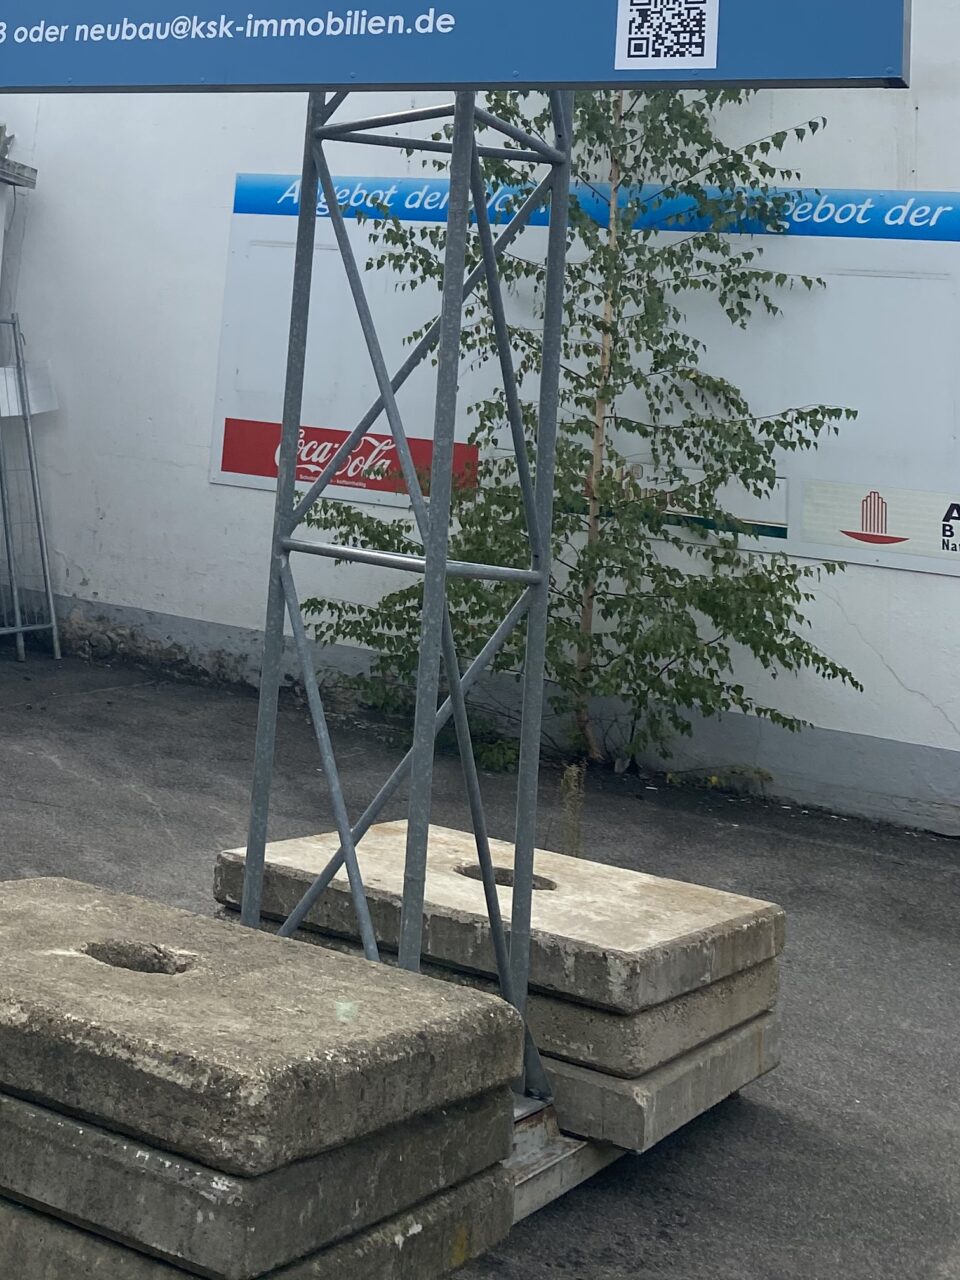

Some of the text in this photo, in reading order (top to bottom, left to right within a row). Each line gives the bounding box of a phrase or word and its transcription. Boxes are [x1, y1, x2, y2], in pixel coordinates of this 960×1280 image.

[13, 20, 69, 44] oder
[74, 7, 456, 42] neubau@ksk-immobilien.de
[277, 176, 398, 216] Agebot
[884, 197, 953, 227] der
